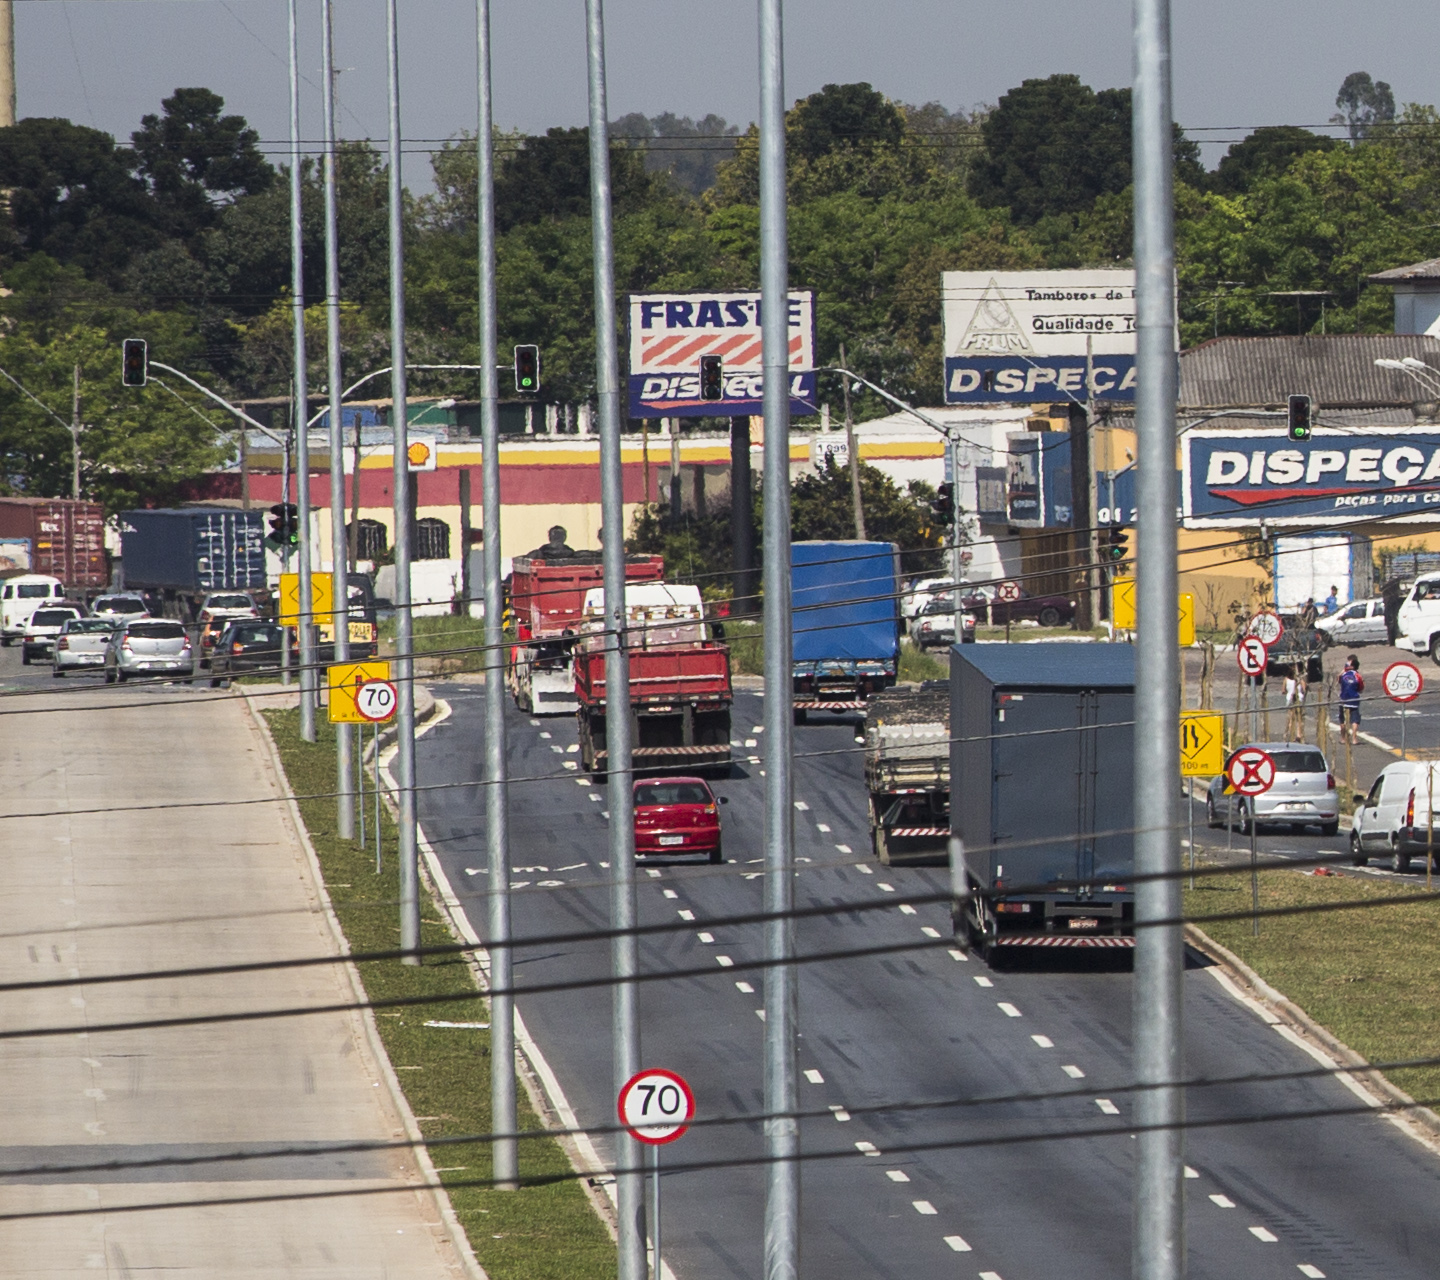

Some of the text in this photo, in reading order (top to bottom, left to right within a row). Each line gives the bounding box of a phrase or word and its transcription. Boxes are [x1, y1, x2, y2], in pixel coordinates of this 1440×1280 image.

[1032, 316, 1114, 332] Qualidade
[949, 366, 1138, 394] DSPEÇA
[366, 688, 391, 707] 70
[637, 1084, 681, 1116] 70
